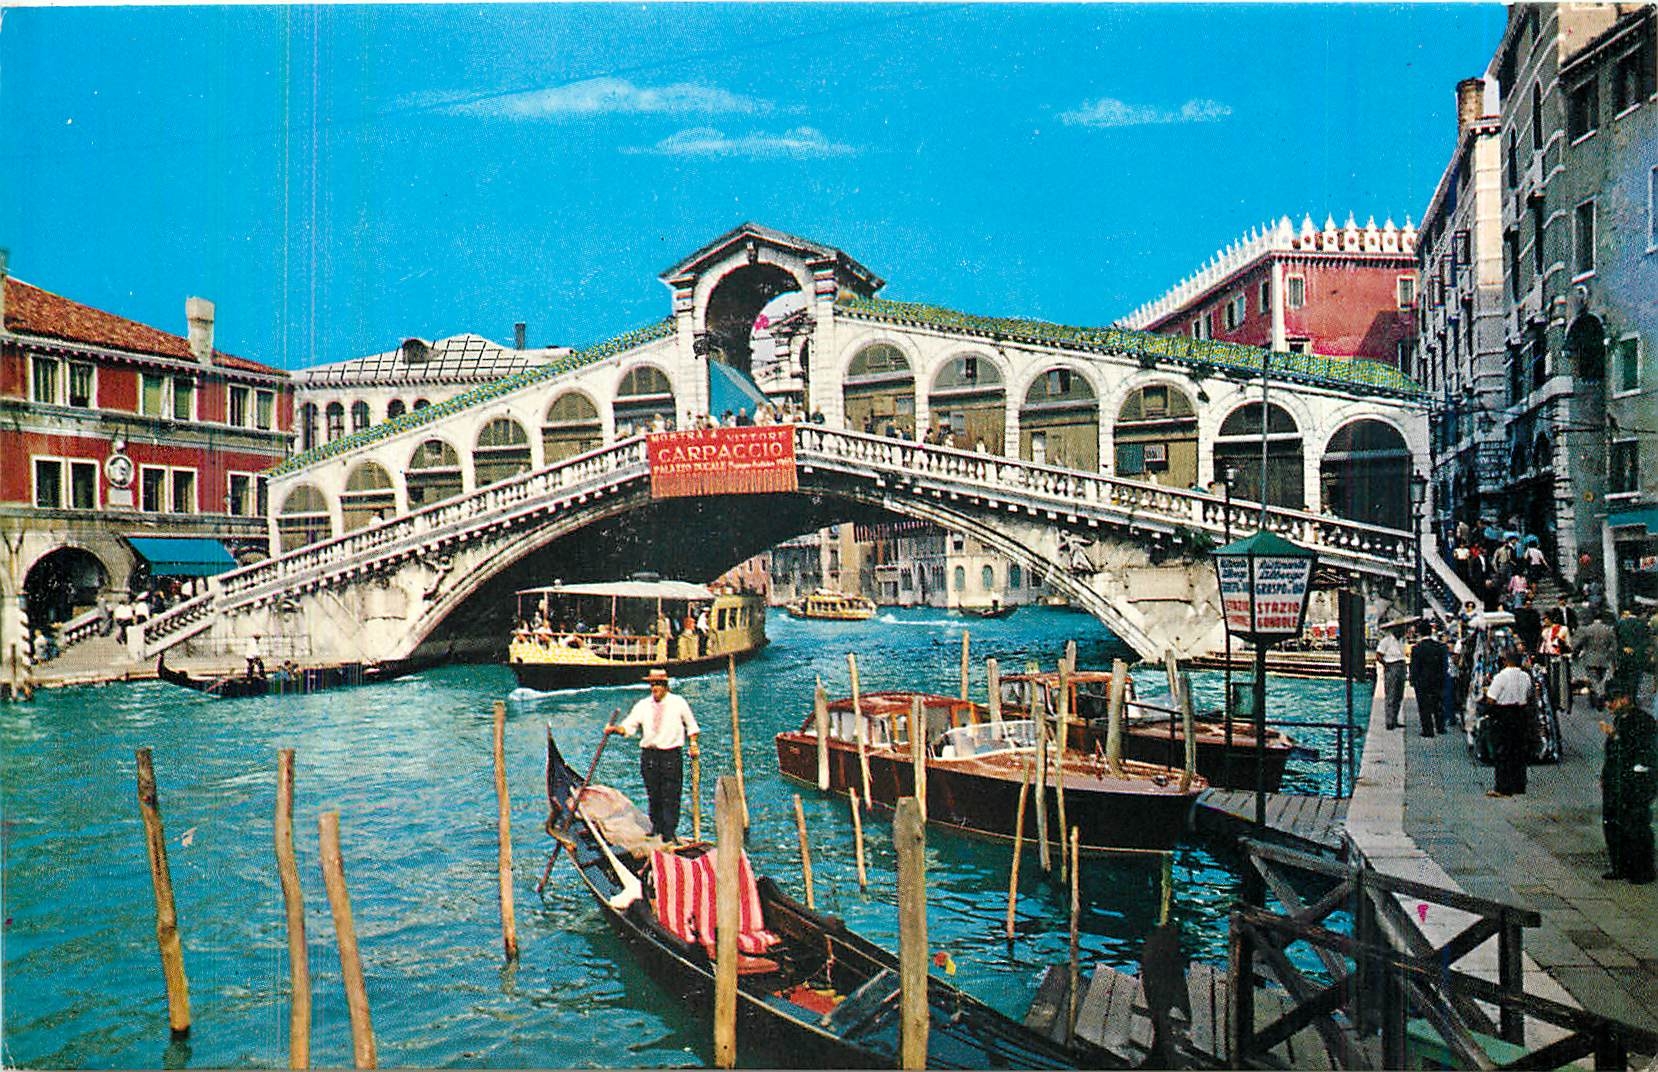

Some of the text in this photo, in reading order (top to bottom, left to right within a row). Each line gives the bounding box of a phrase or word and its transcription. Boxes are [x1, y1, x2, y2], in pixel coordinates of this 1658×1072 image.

[726, 431, 787, 442] VITTORE
[658, 442, 783, 463] CARPACCIO
[1256, 601, 1300, 614] STAZIO
